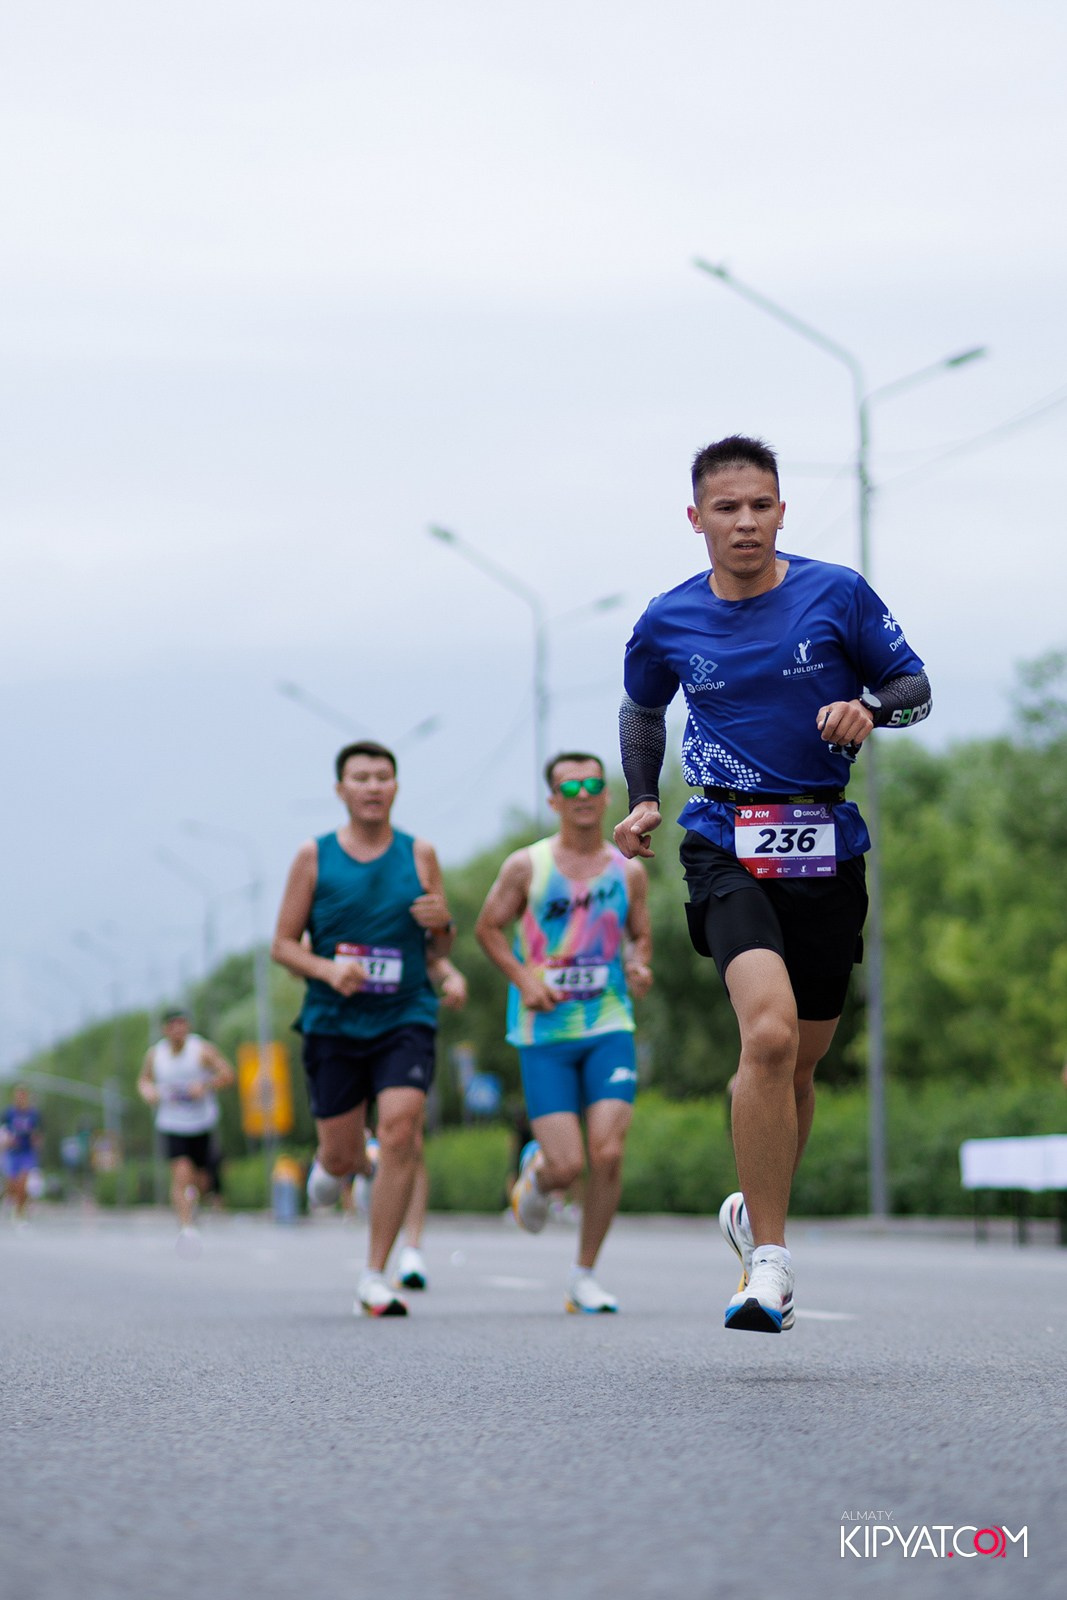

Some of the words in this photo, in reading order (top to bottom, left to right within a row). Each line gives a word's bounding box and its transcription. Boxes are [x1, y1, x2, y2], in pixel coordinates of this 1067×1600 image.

[695, 680, 725, 692] GROUP
[740, 809, 753, 819] 10
[754, 810, 770, 818] KM
[754, 827, 818, 854] 236
